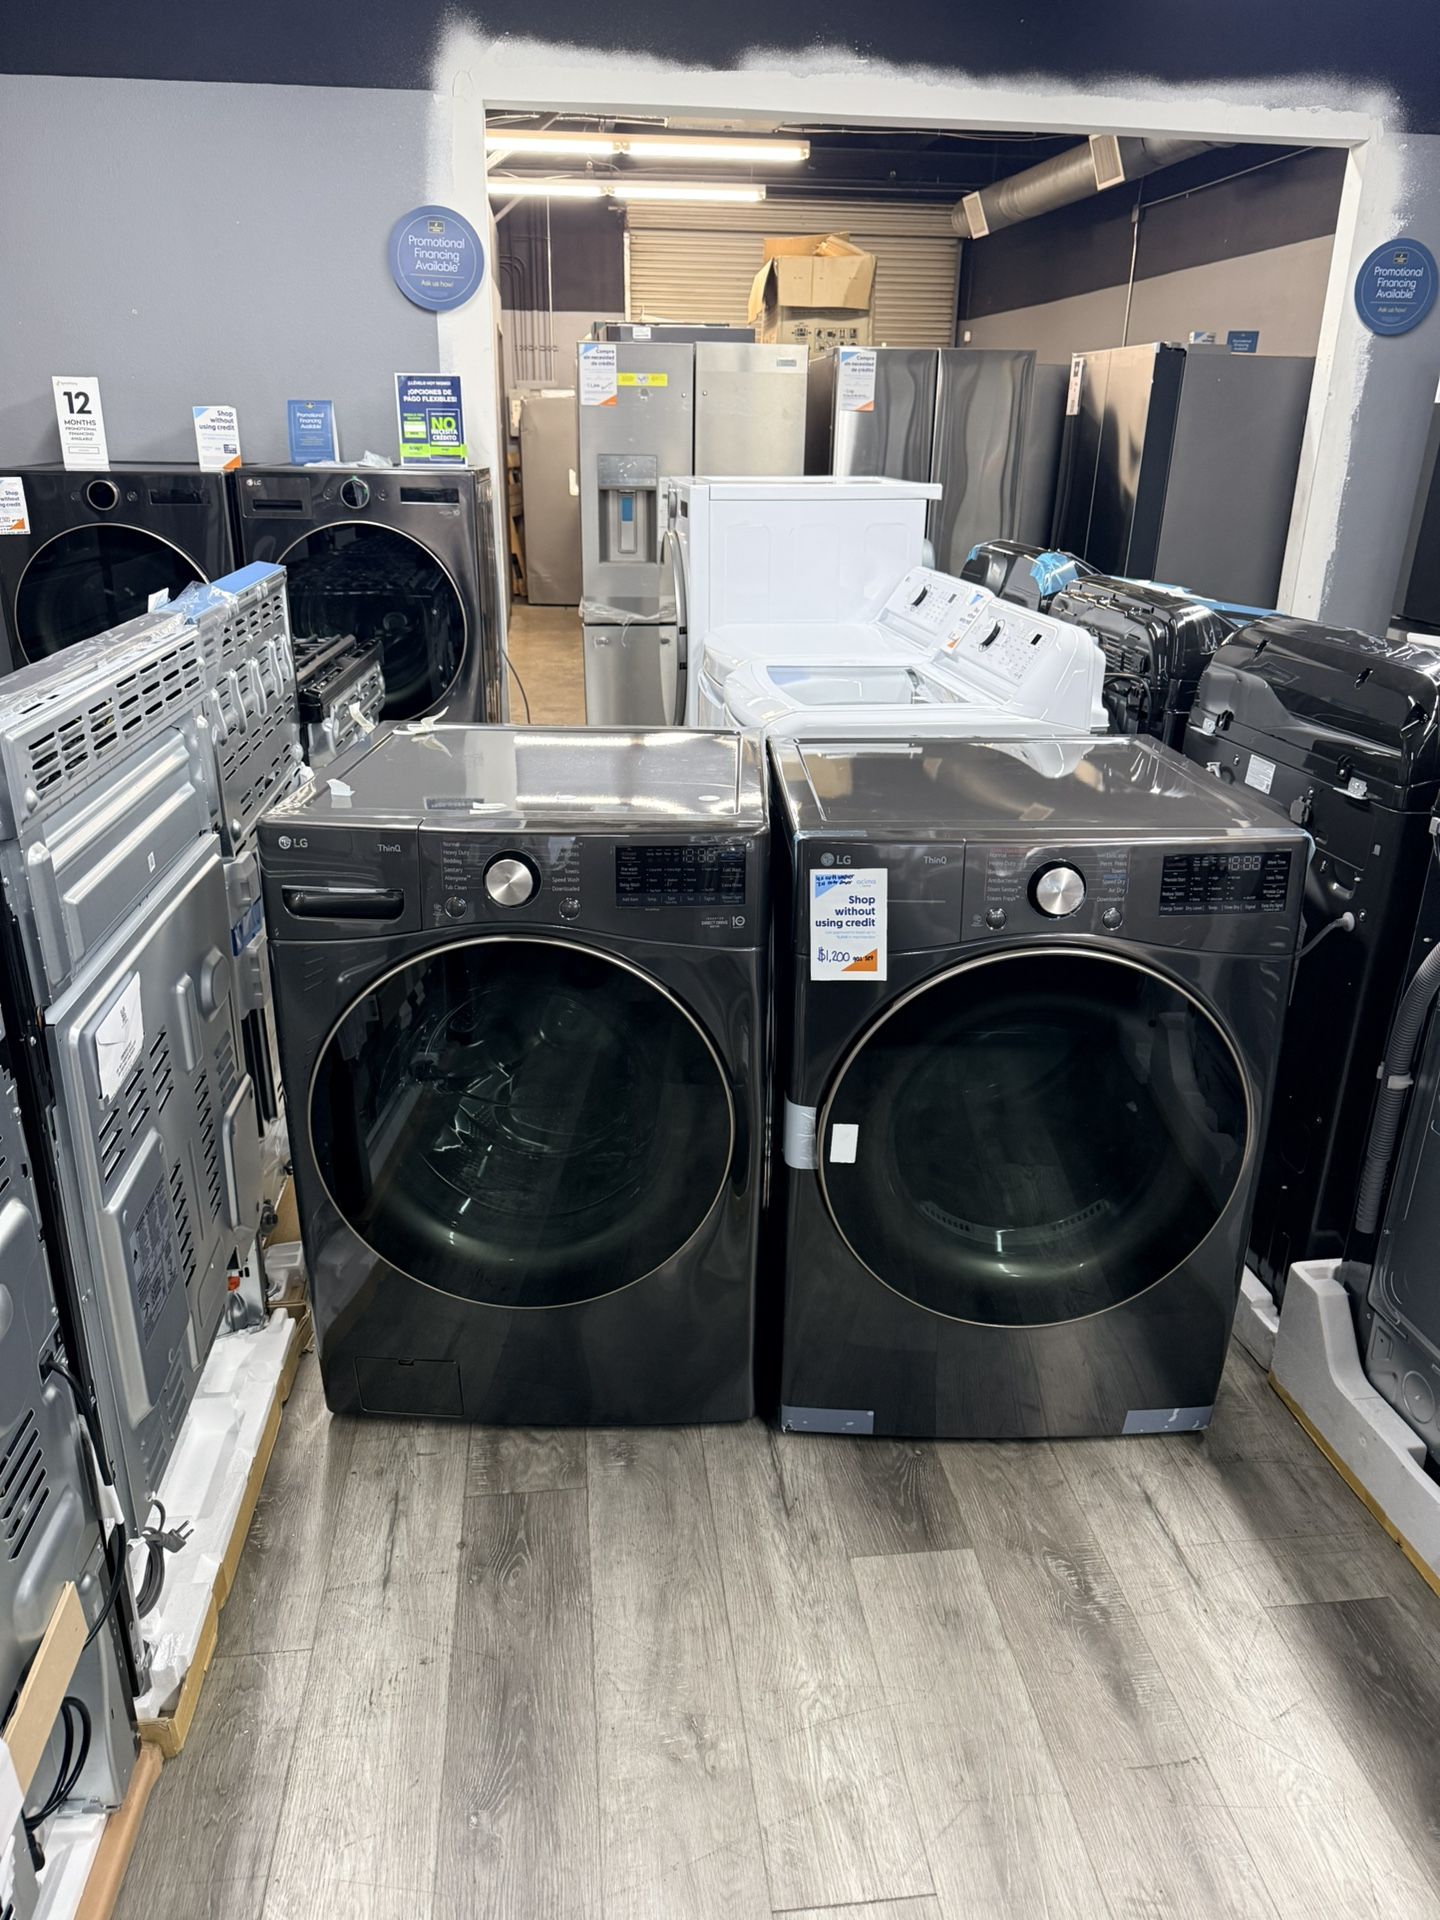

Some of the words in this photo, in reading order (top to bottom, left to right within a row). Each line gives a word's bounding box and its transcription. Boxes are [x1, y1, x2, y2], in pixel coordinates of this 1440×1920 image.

[408, 234, 466, 249] Promotional
[414, 247, 460, 264] Financing
[1374, 266, 1425, 278] Promotional
[1376, 277, 1418, 290] Financing
[63, 391, 93, 415] 12
[216, 410, 234, 418] Shop
[210, 416, 234, 424] without
[431, 416, 457, 430] NO
[376, 843, 402, 853] ThinQ
[923, 855, 947, 865] ThinQ
[848, 895, 876, 906] Shop
[834, 907, 876, 916] without
[815, 918, 844, 929] using
[845, 918, 876, 928] credit
